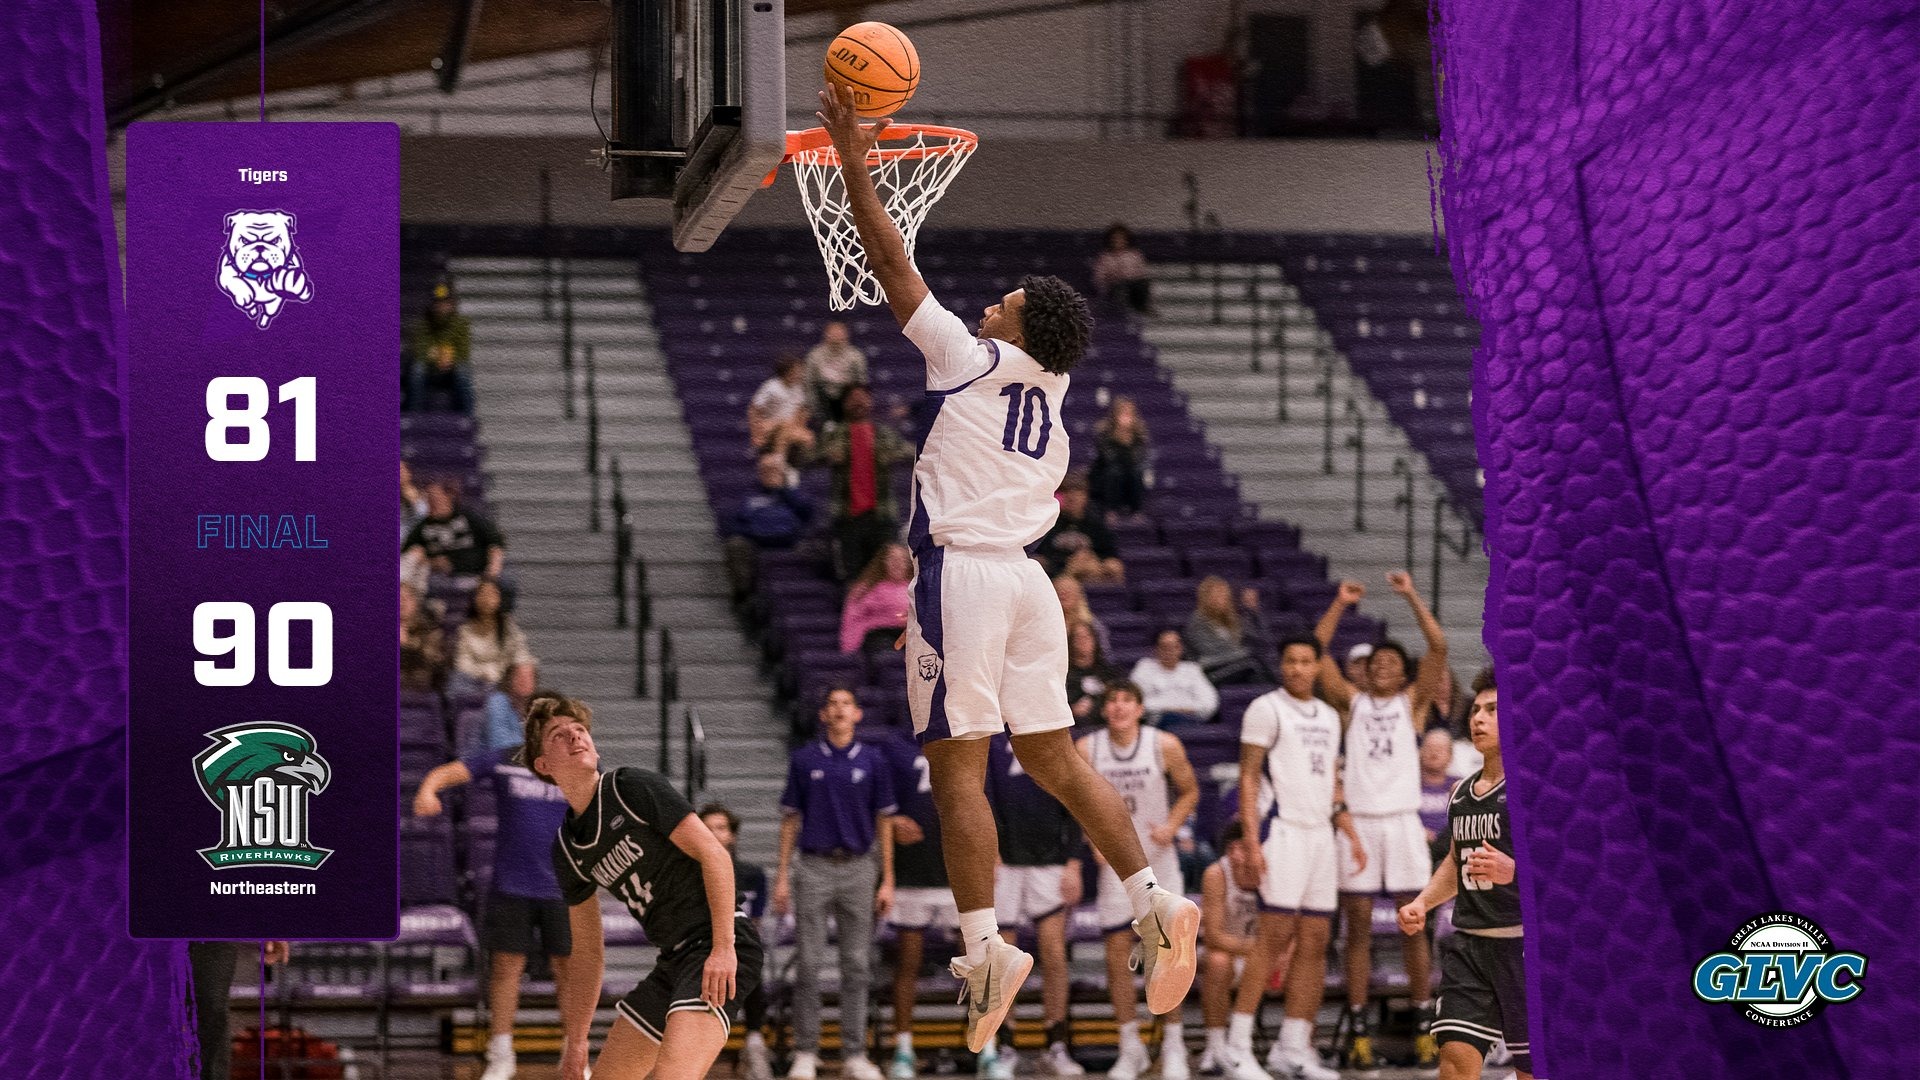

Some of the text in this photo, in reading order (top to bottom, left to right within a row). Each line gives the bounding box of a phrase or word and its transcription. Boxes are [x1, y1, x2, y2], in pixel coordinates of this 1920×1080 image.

[835, 47, 870, 72] EVO
[999, 382, 1053, 460] 10
[1452, 812, 1501, 841] WARRIORS
[590, 834, 644, 888] WARRIORS
[620, 872, 654, 917] 14
